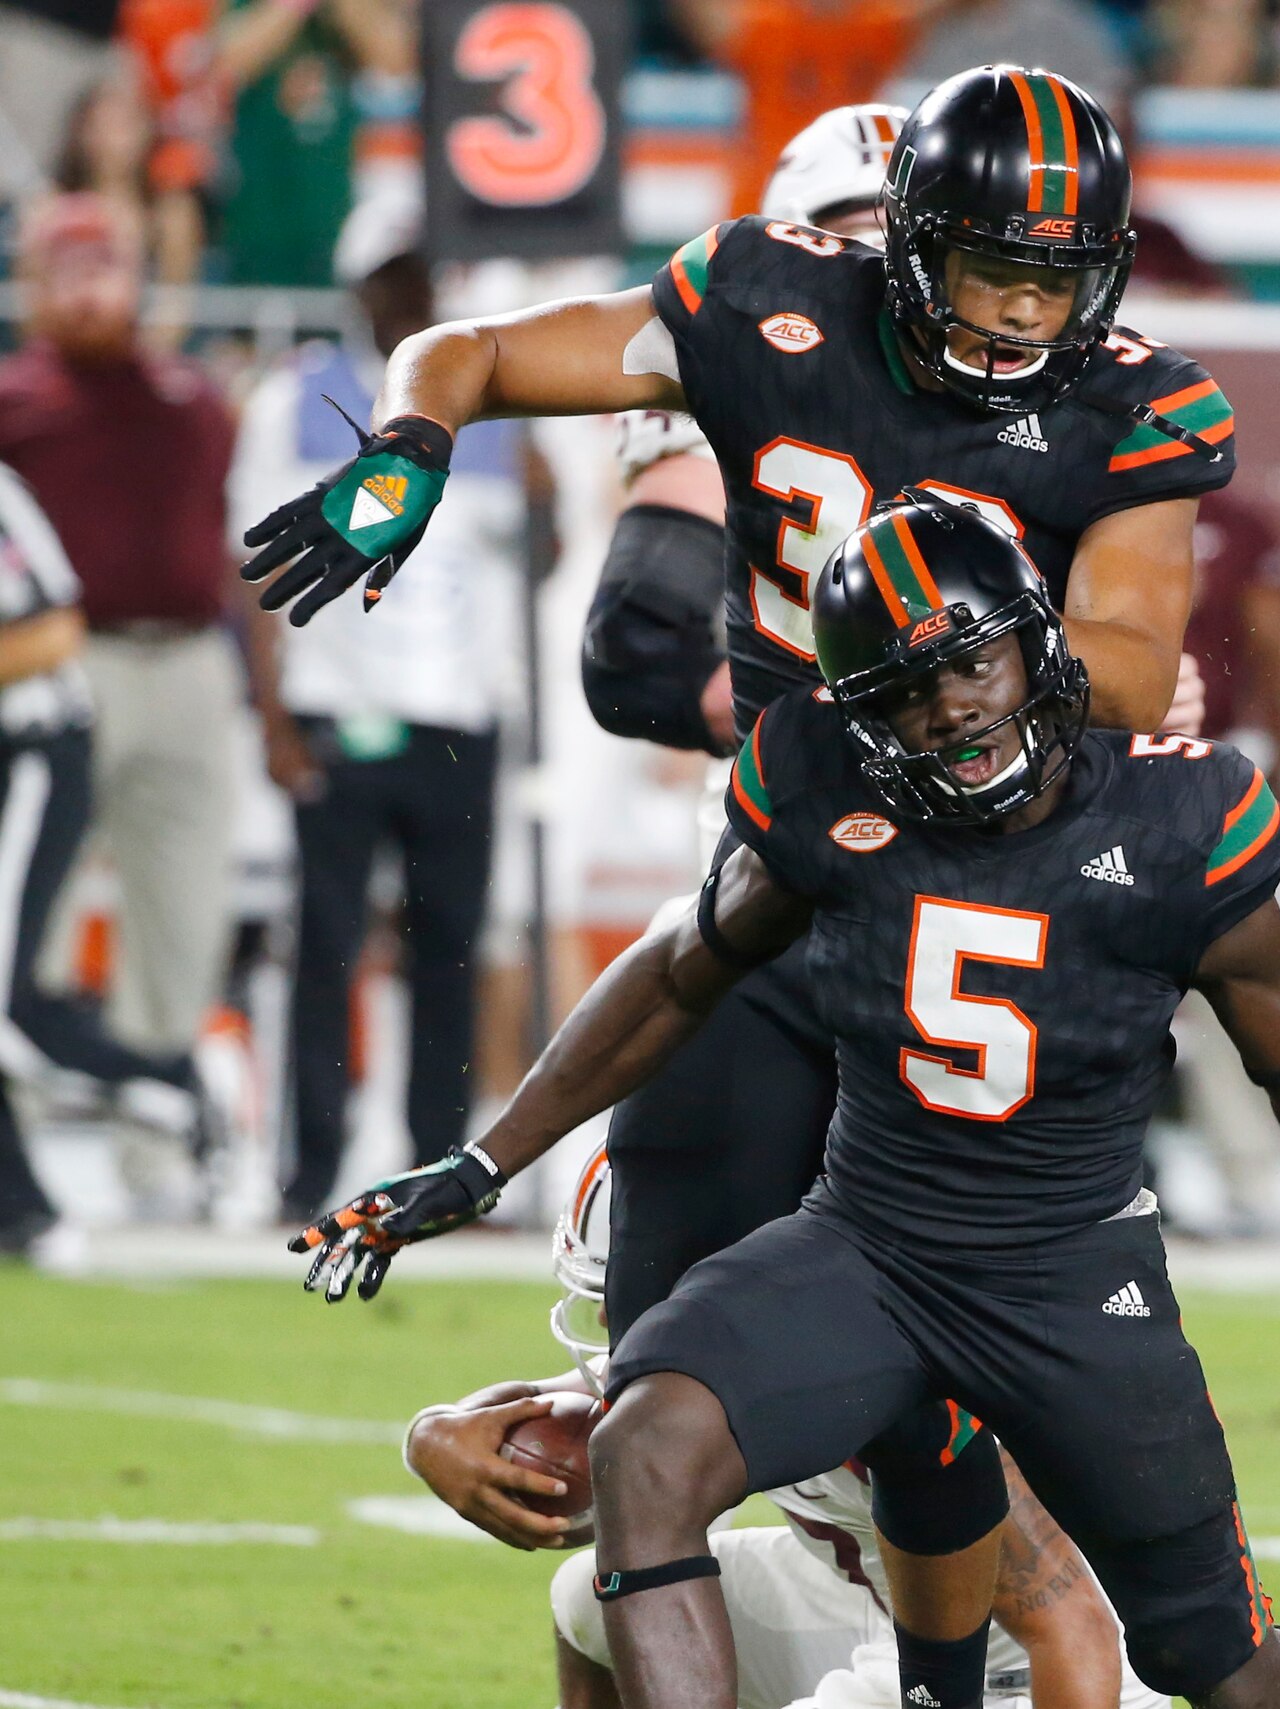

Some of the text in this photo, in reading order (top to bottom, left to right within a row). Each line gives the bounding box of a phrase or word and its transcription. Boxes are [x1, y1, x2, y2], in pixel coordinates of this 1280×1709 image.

[447, 5, 606, 206] 3
[1032, 219, 1076, 234] ACC
[769, 322, 816, 342] ACC
[997, 430, 1049, 453] adidas
[362, 478, 404, 517] adidas
[910, 611, 949, 642] ACC
[840, 821, 888, 838] ACC
[1080, 864, 1135, 886] adidas
[900, 894, 1050, 1122] 5
[1101, 1301, 1151, 1317] adidas
